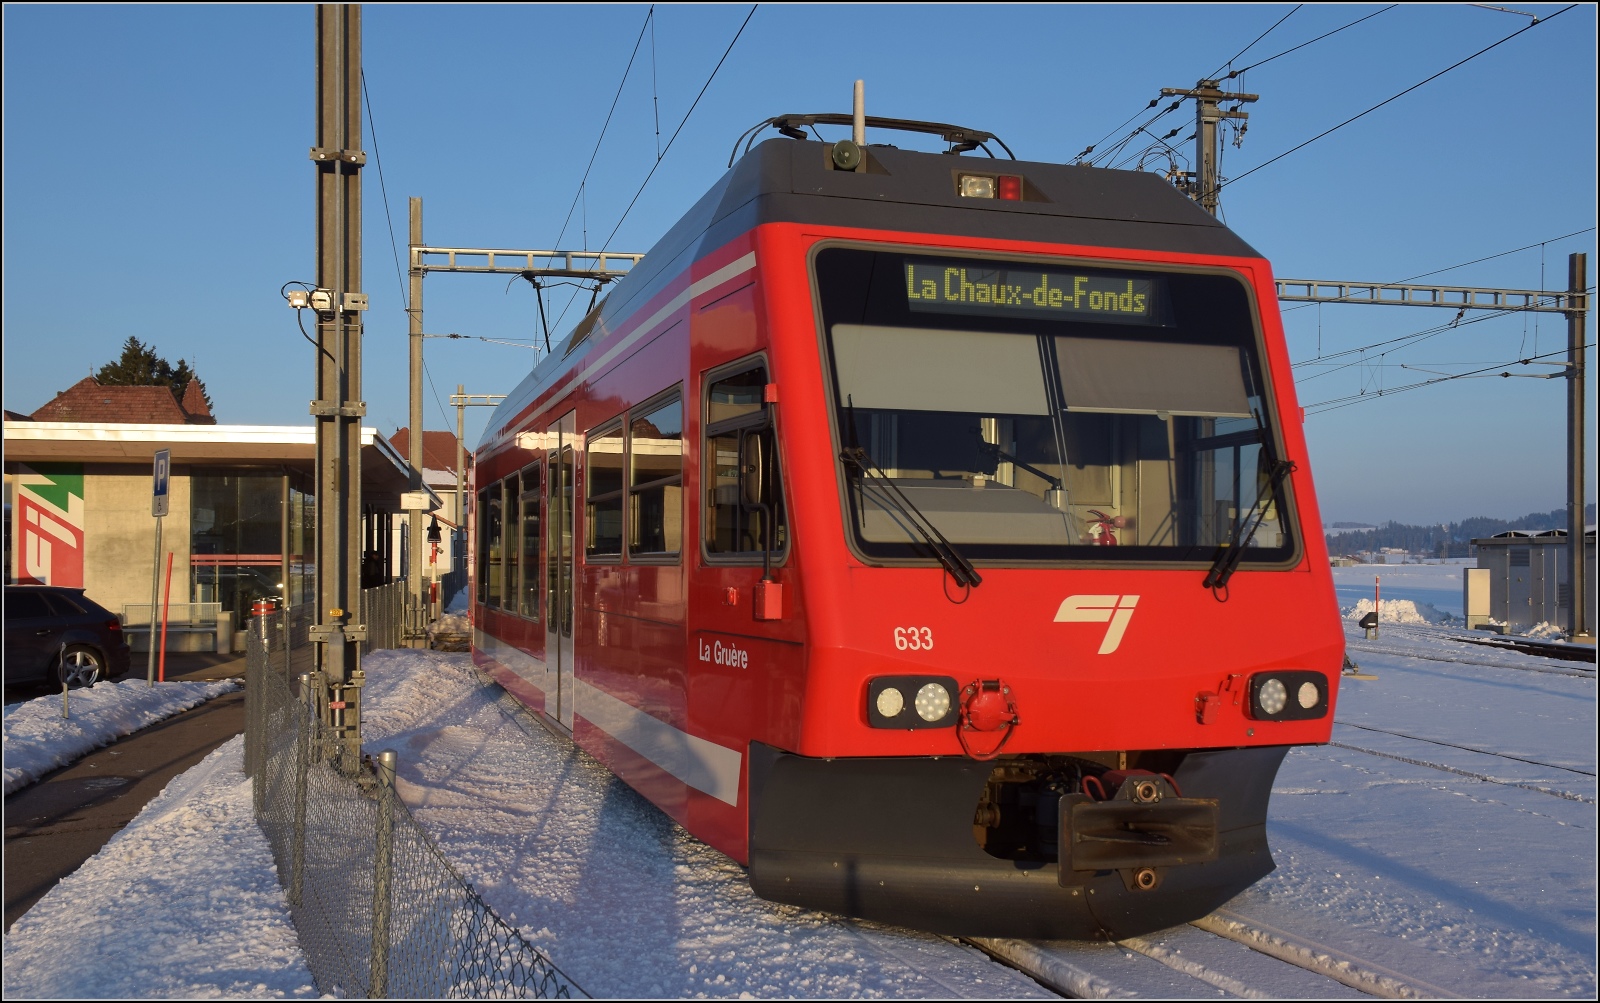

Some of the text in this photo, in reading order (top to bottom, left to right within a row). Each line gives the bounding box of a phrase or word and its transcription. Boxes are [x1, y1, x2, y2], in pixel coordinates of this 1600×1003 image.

[908, 265, 1145, 312] La Chaux-de-Fonds
[157, 459, 166, 490] P
[699, 638, 748, 669] La Gruère
[893, 626, 934, 651] 633
